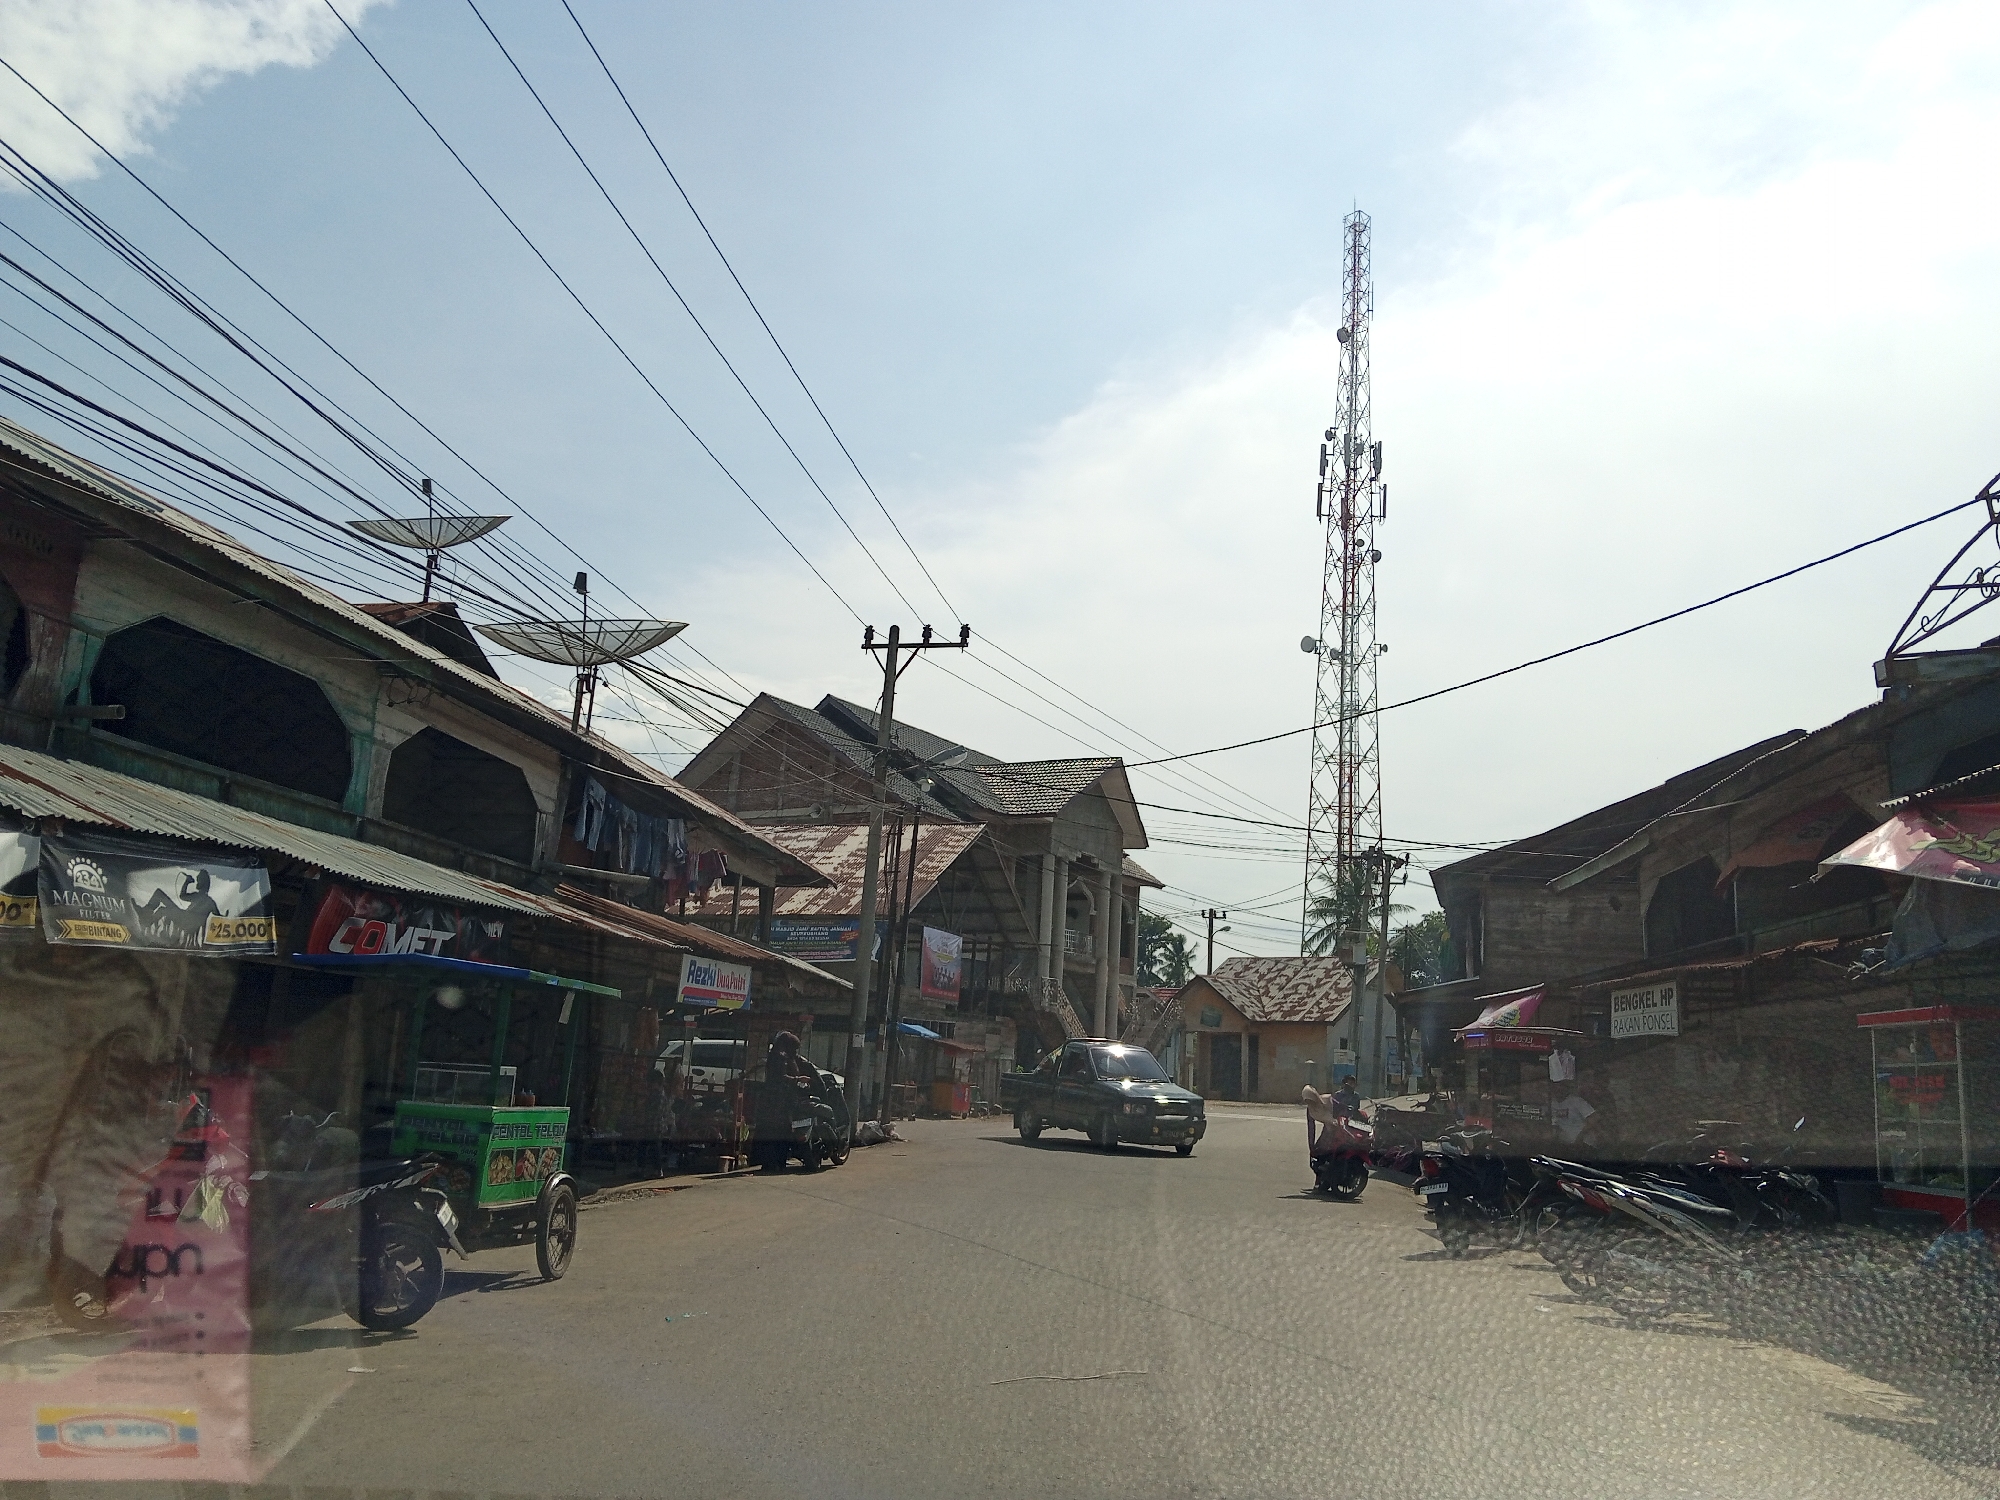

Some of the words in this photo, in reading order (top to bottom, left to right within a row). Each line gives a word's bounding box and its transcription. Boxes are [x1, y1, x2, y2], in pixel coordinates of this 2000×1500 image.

[52, 890, 126, 914] MAGNUM
[79, 908, 112, 921] FILTER
[88, 925, 122, 938] BINTANG
[1613, 990, 1658, 1013] BENGKEL
[1660, 987, 1674, 1007] HP
[1613, 1016, 1640, 1035] RAKAN
